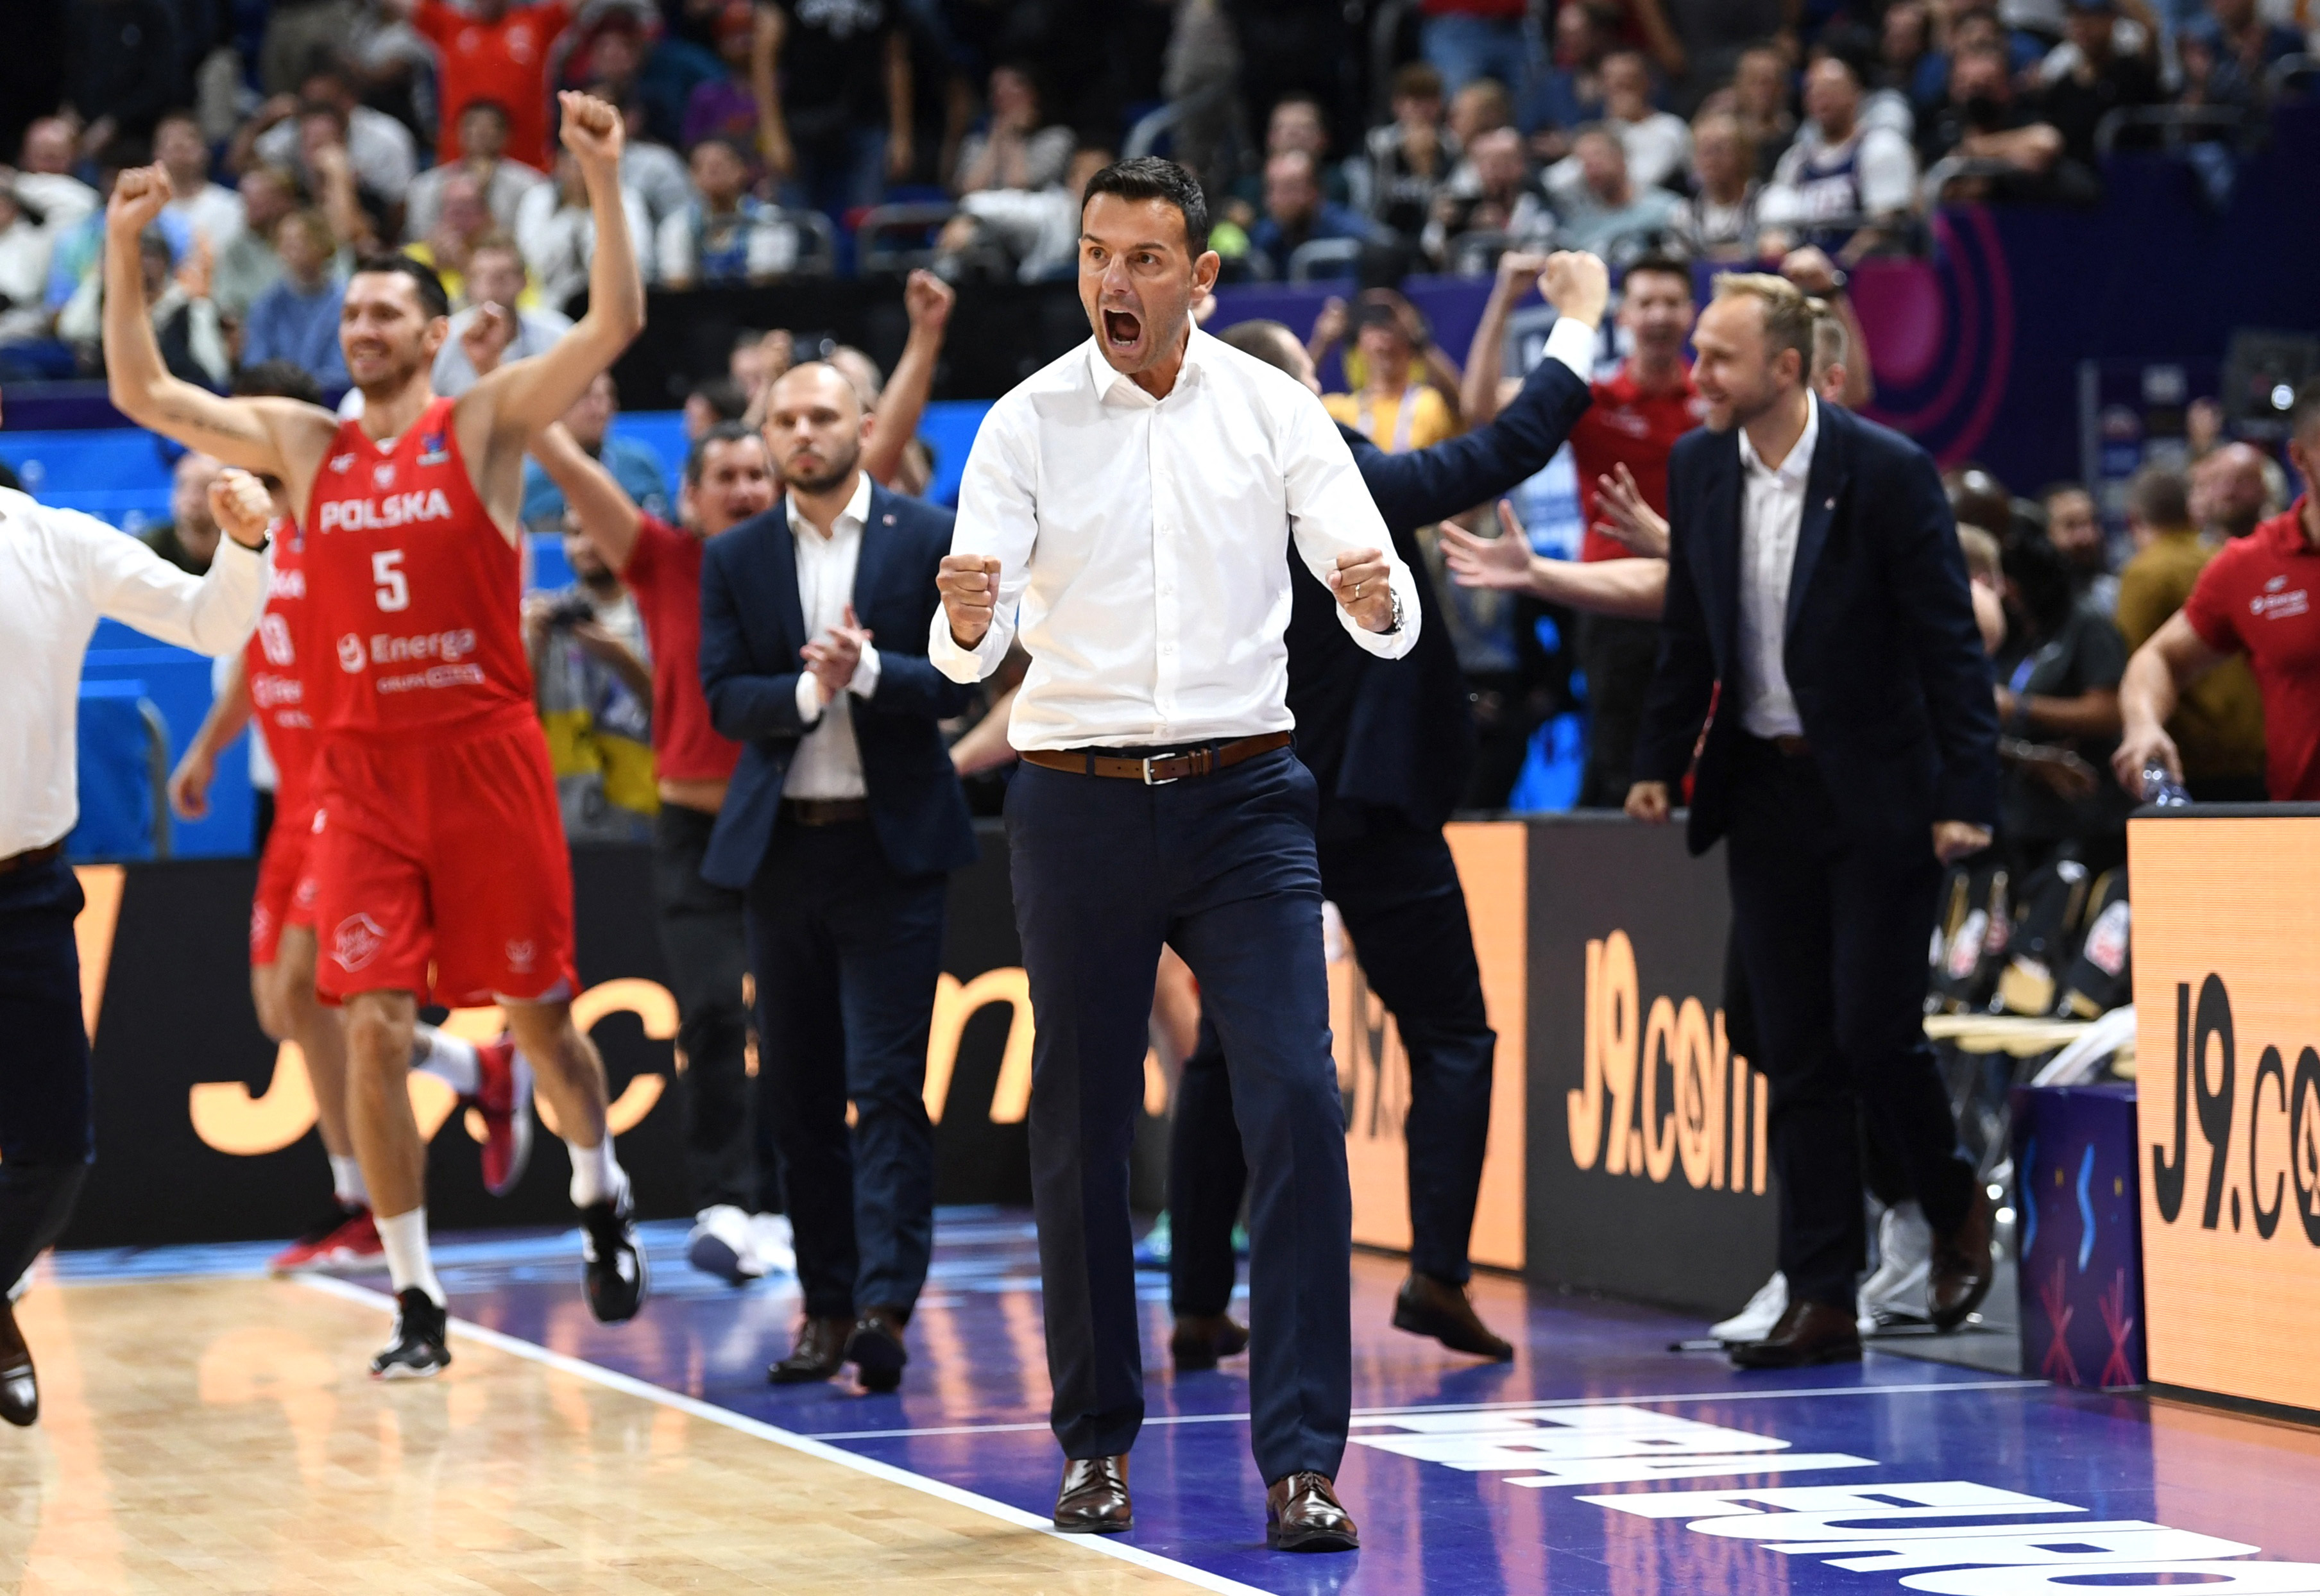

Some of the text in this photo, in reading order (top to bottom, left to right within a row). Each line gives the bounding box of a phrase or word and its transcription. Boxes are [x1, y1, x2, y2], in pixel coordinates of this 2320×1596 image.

[320, 488, 453, 534] POLSKA
[371, 548, 411, 613] 5
[370, 627, 477, 664] Energa
[1567, 928, 1769, 1196] J9.com
[1347, 1405, 1880, 1488] FIBA
